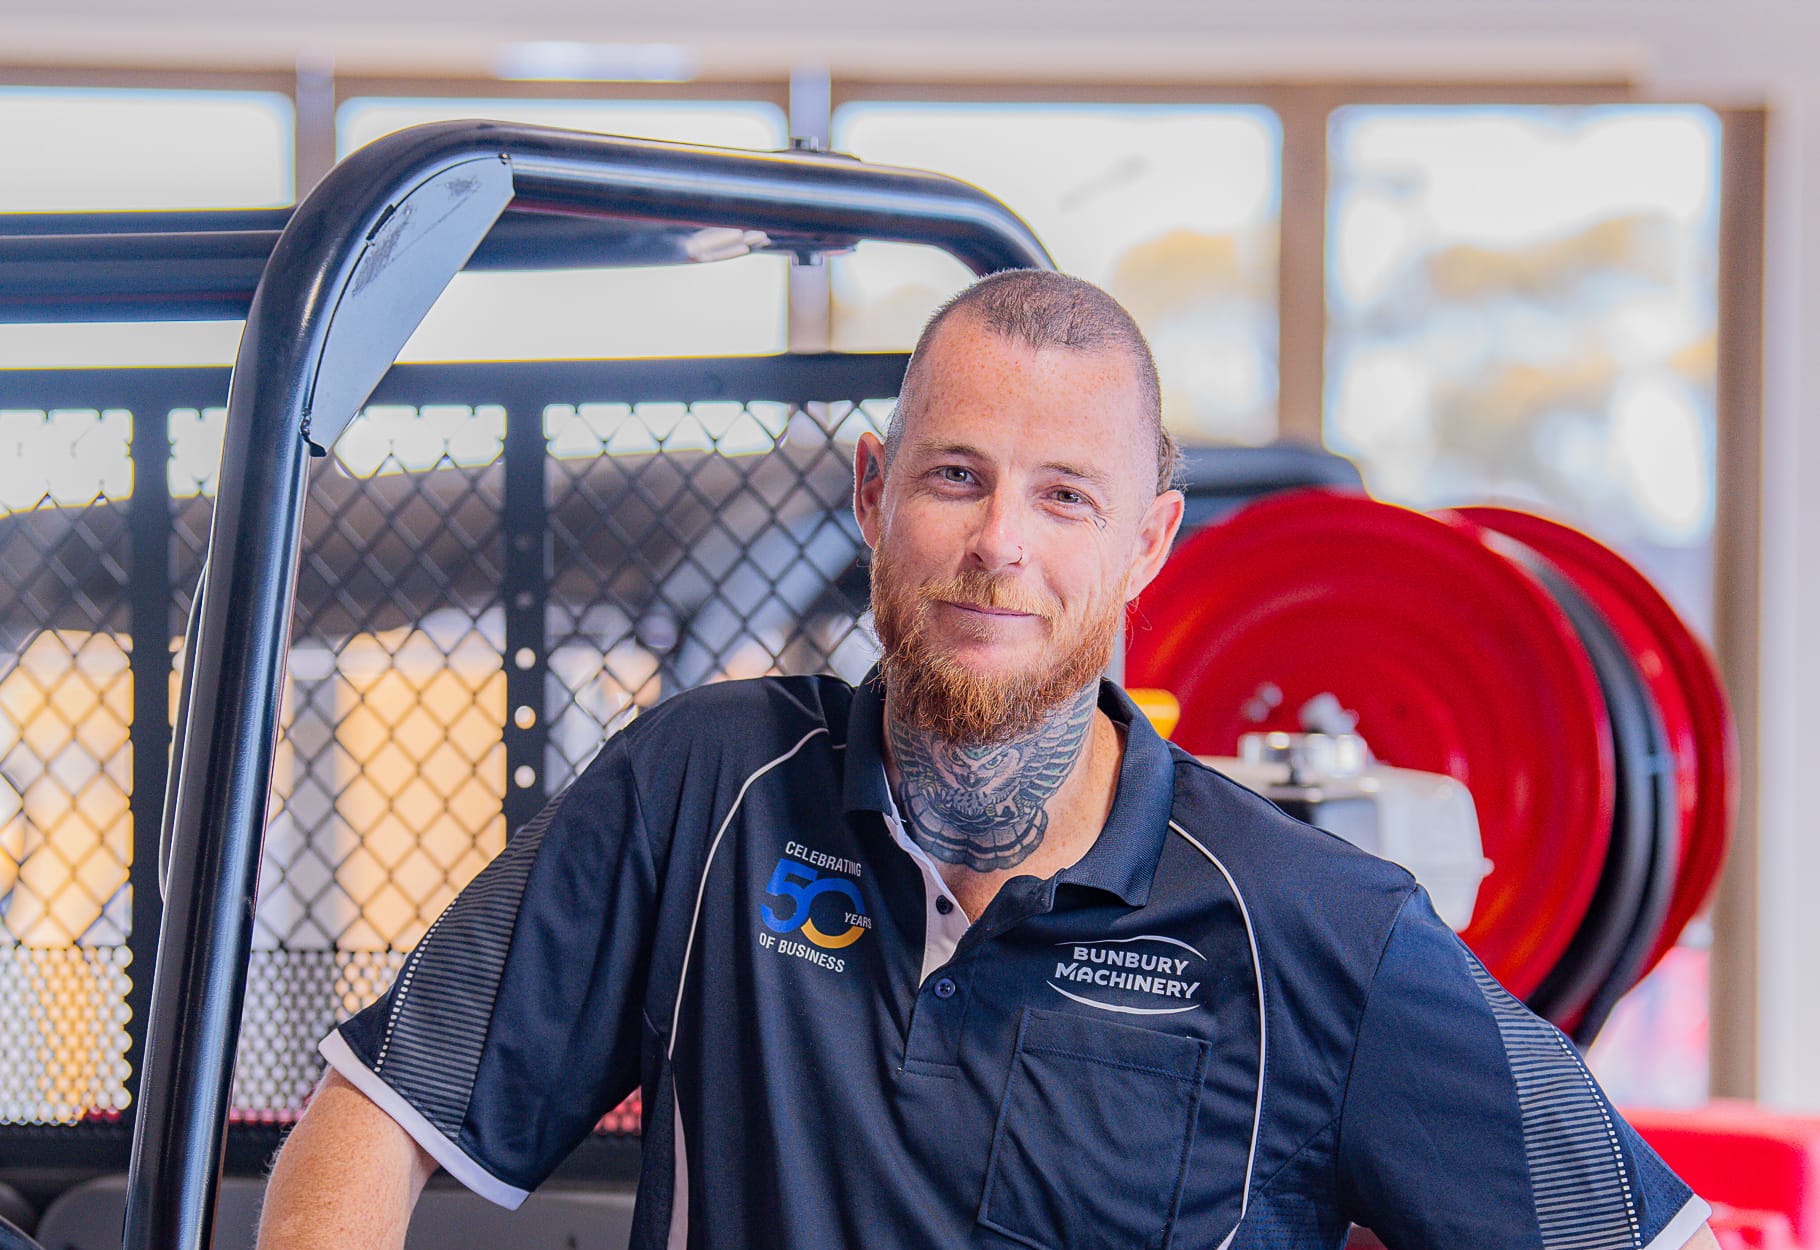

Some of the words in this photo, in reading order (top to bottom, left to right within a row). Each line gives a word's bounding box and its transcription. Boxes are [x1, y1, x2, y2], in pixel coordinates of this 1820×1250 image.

[785, 840, 862, 877] CELEBRATING
[760, 857, 865, 949] 50
[844, 911, 872, 930] YEARS
[759, 932, 775, 950] OF
[777, 940, 845, 973] BUSINESS
[1073, 946, 1189, 975] BUNBURY
[1055, 961, 1201, 999] MACHINERY
